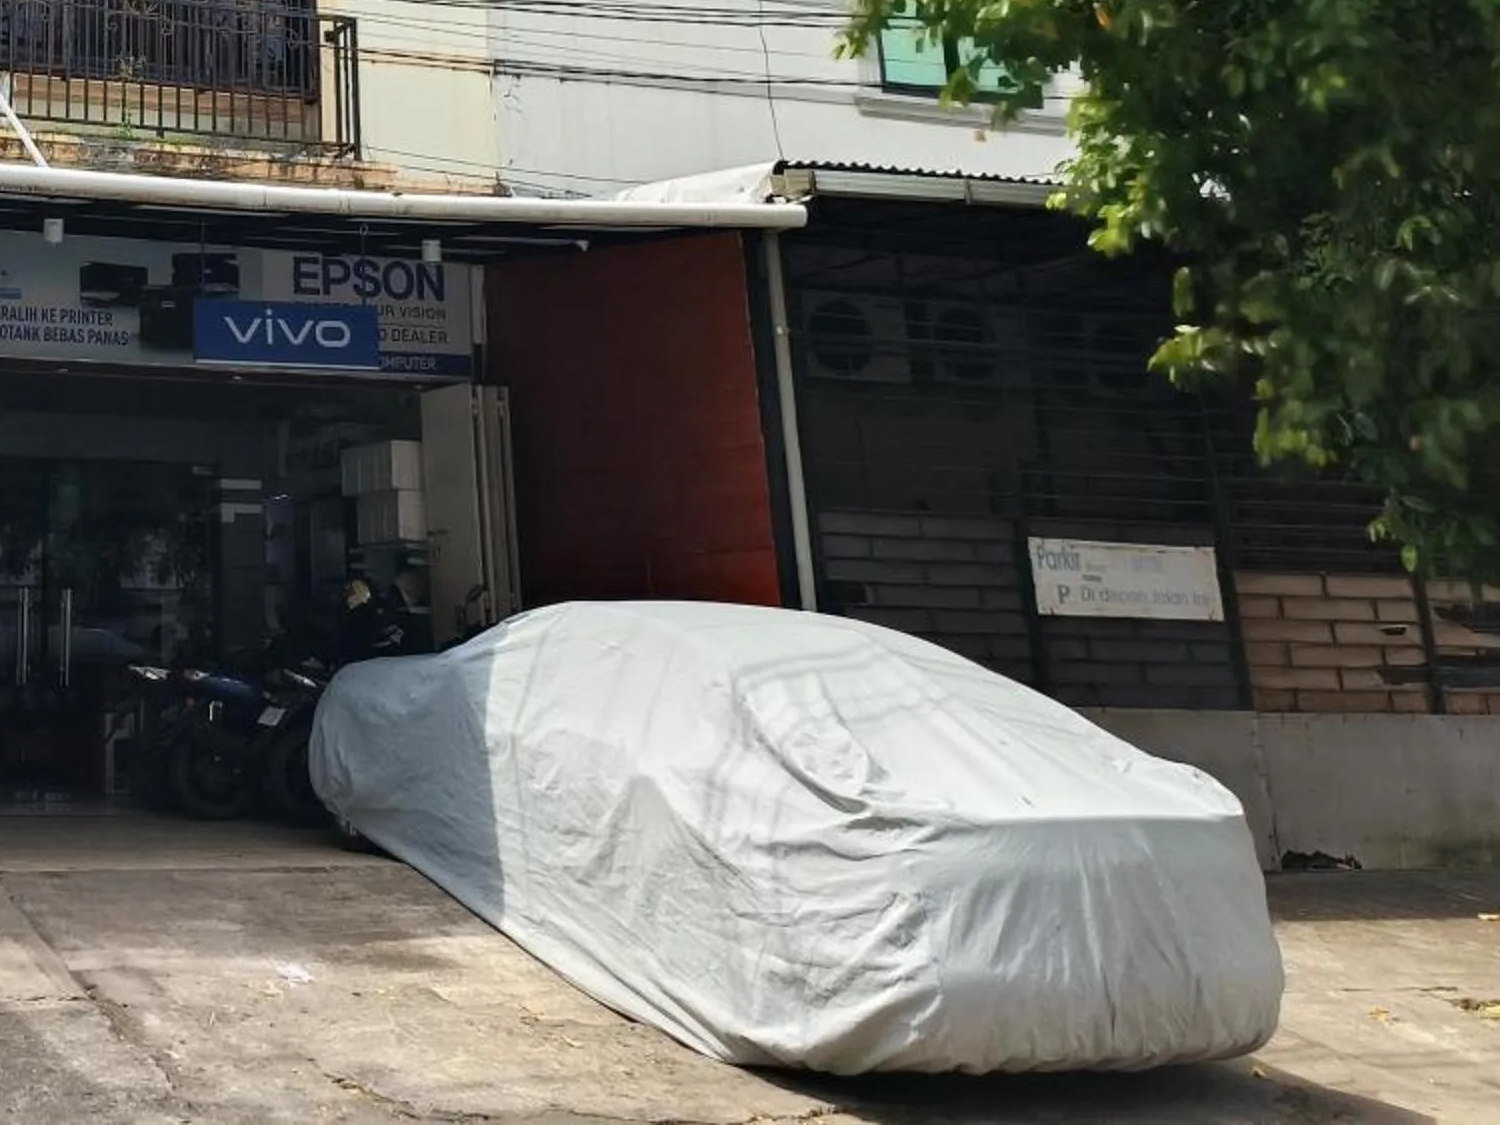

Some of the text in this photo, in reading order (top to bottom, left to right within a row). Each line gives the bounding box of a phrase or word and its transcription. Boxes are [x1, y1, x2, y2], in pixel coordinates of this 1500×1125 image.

[293, 255, 445, 302] EPSON
[41, 306, 58, 324] KE
[399, 305, 446, 321] VISION
[43, 327, 86, 345] BEBAS
[87, 329, 131, 346] PANAS
[223, 308, 351, 348] vivo
[391, 328, 448, 345] DEALER
[1057, 584, 1071, 605] P
